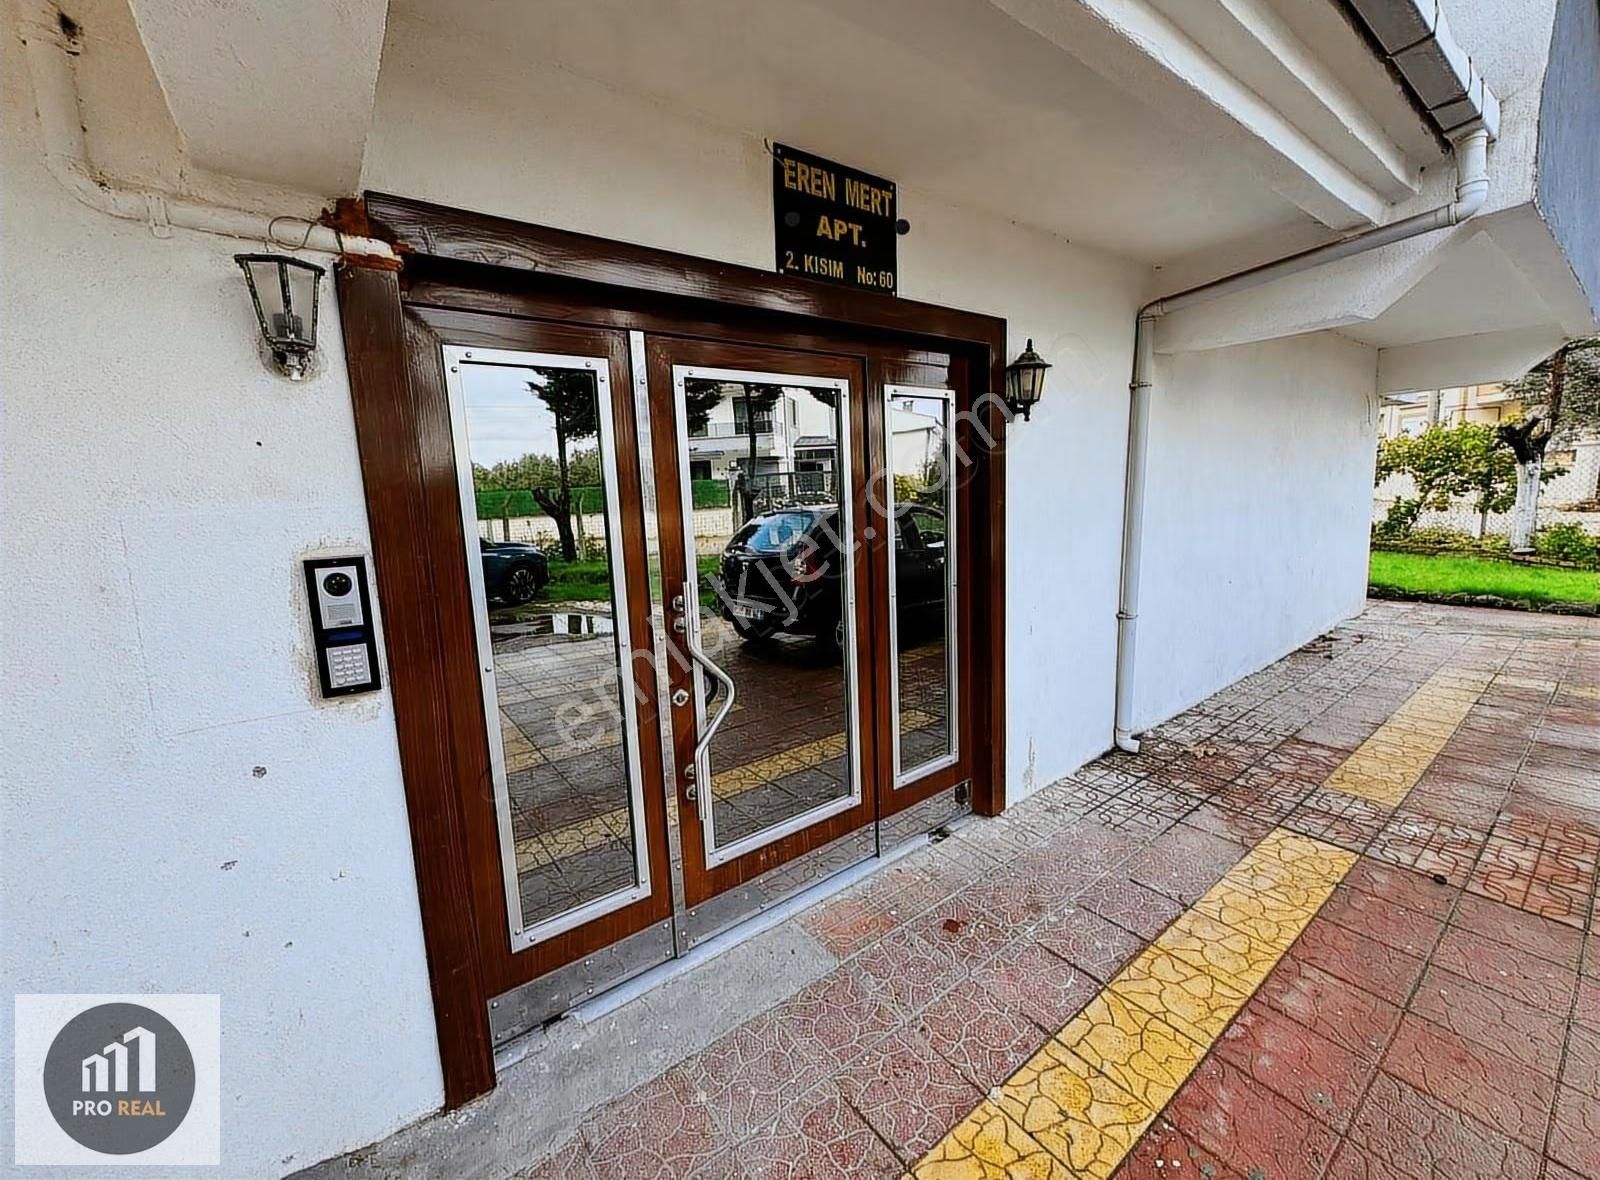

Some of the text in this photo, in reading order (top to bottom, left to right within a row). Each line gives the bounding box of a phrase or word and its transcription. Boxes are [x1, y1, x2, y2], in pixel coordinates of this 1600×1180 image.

[784, 158, 892, 216] EREN MERT
[816, 215, 866, 247] APT.
[785, 251, 799, 269] 2.
[804, 254, 843, 279] KISIM
